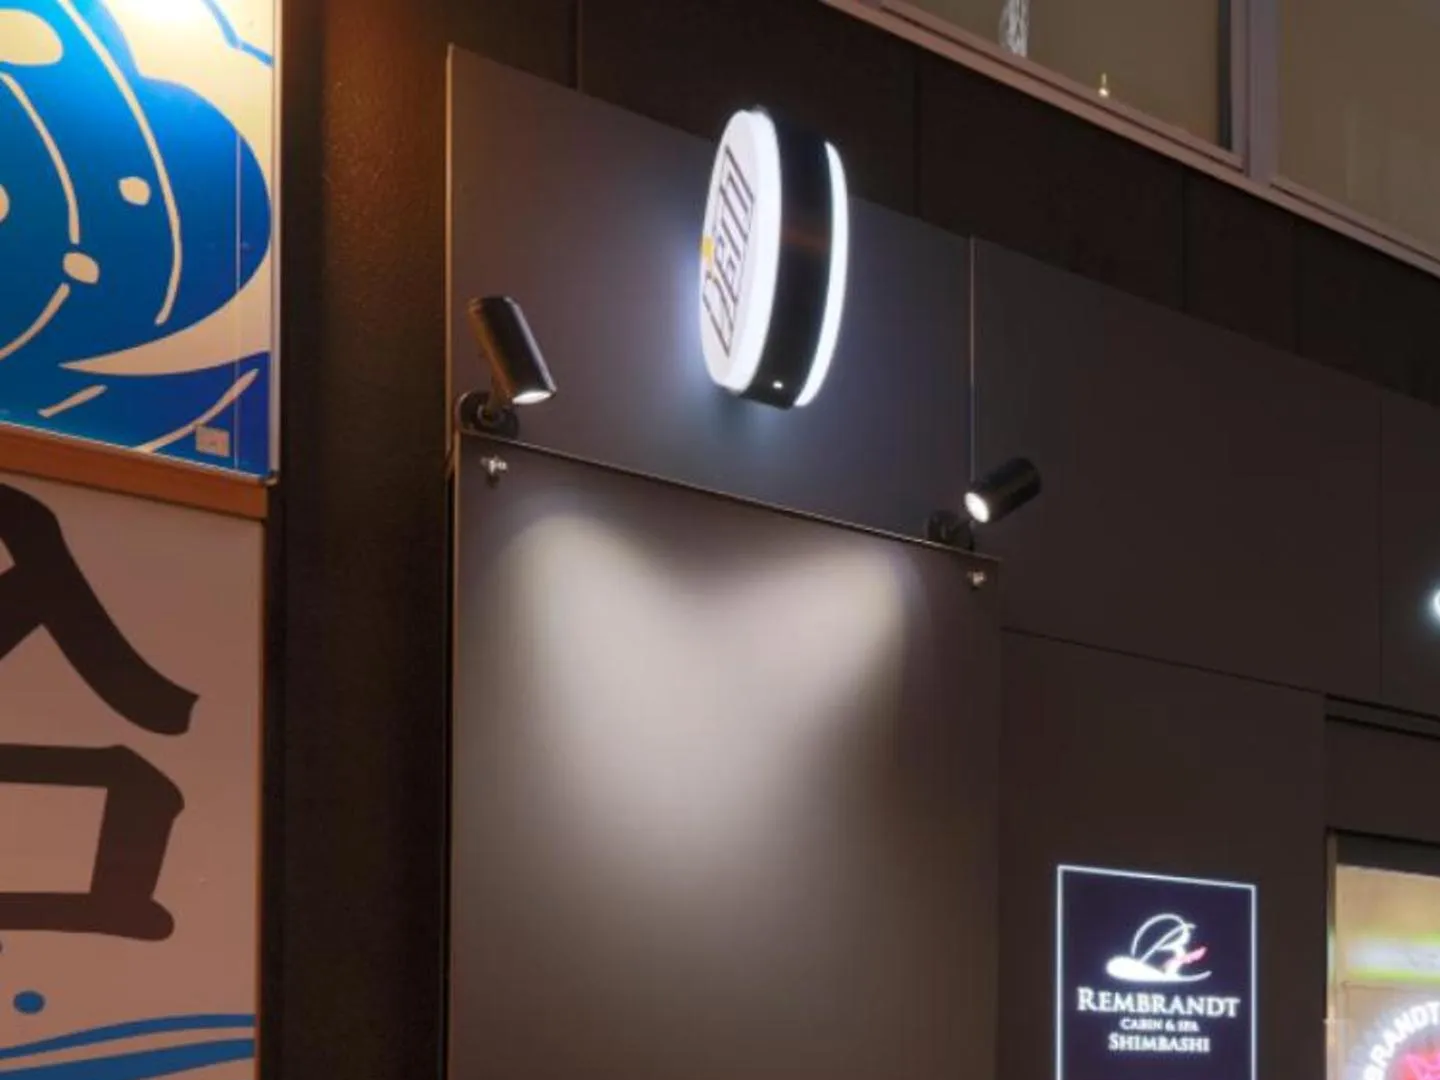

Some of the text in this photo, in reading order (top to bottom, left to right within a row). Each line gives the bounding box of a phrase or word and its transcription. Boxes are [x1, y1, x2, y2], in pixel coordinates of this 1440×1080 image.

[1077, 986, 1241, 1018] REMBRANDT
[1120, 1017, 1199, 1032] CABIN & SPA
[1108, 1032, 1211, 1053] SHIMBASHI
